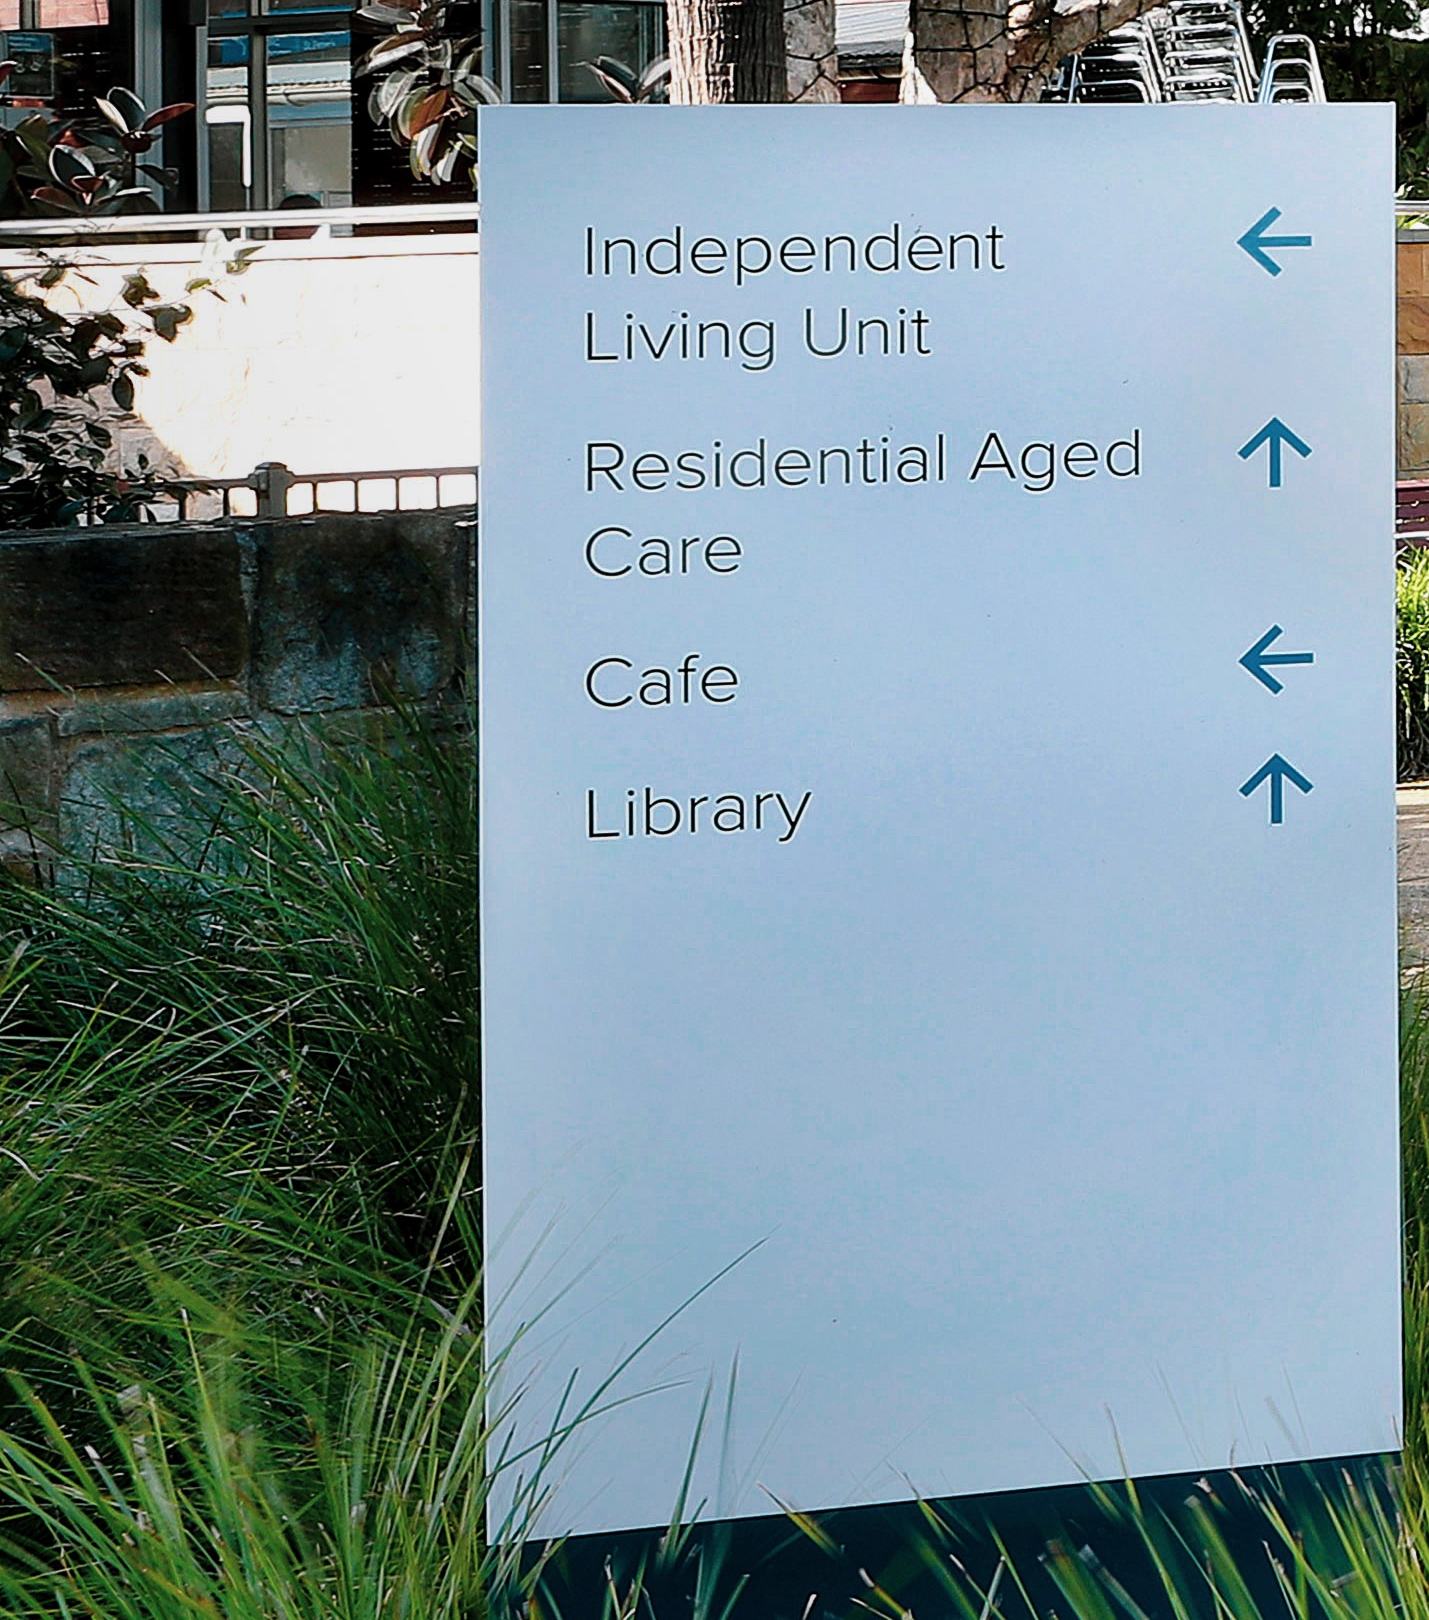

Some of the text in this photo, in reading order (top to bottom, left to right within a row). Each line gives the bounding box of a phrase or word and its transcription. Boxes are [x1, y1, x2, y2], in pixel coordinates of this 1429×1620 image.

[585, 222, 1006, 287] Independent
[585, 306, 932, 372] Living Unit
[585, 428, 1141, 493] Residential Aged
[585, 526, 743, 577] Care
[585, 653, 739, 709] Cafe
[586, 787, 813, 843] Library
